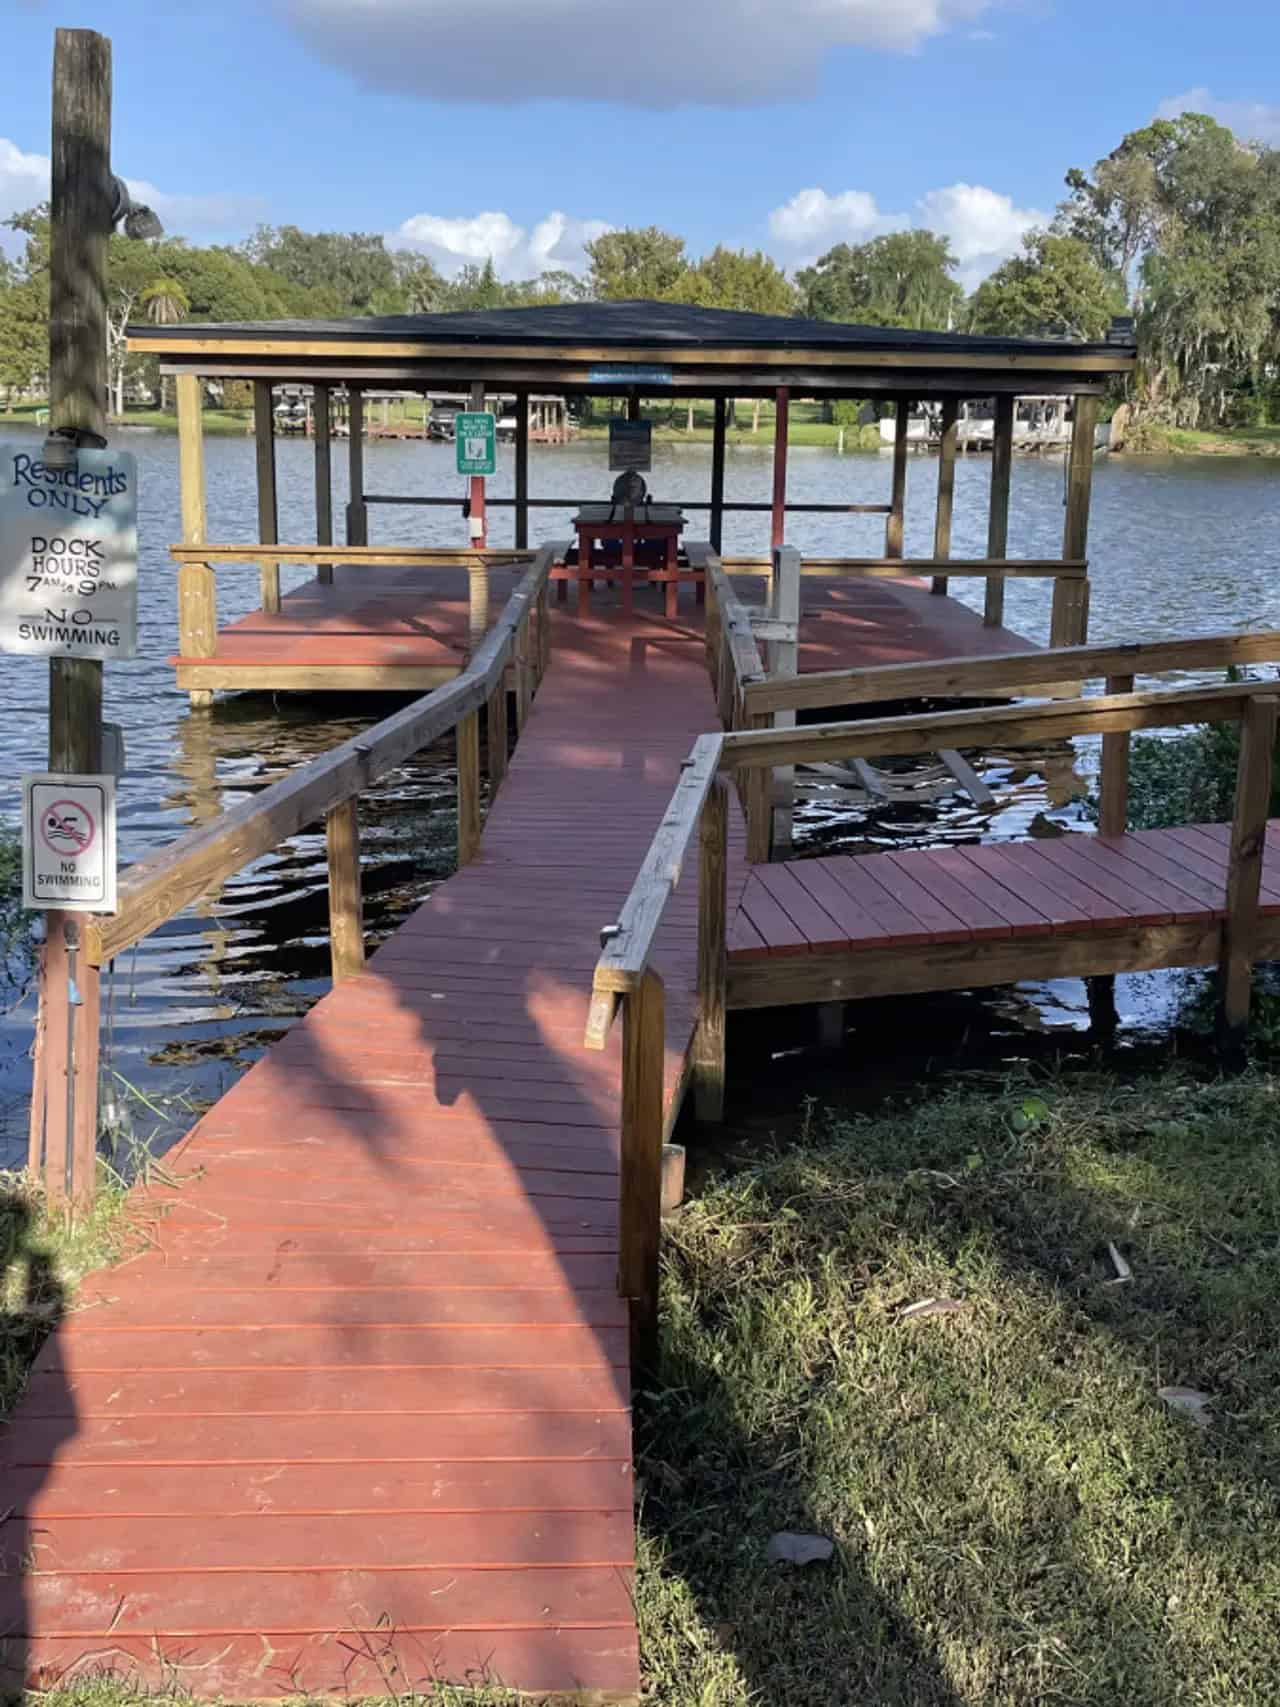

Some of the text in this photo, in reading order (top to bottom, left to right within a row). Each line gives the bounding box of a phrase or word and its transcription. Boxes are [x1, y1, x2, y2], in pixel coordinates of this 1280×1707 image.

[13, 453, 127, 496] Residents
[27, 488, 110, 519] ONLY
[32, 537, 104, 559] DOCK
[33, 556, 100, 577] HOURS
[44, 608, 93, 625] NO
[19, 624, 121, 646] SWIMMING
[60, 861, 76, 873] NO
[37, 874, 100, 887] SWIMMING
